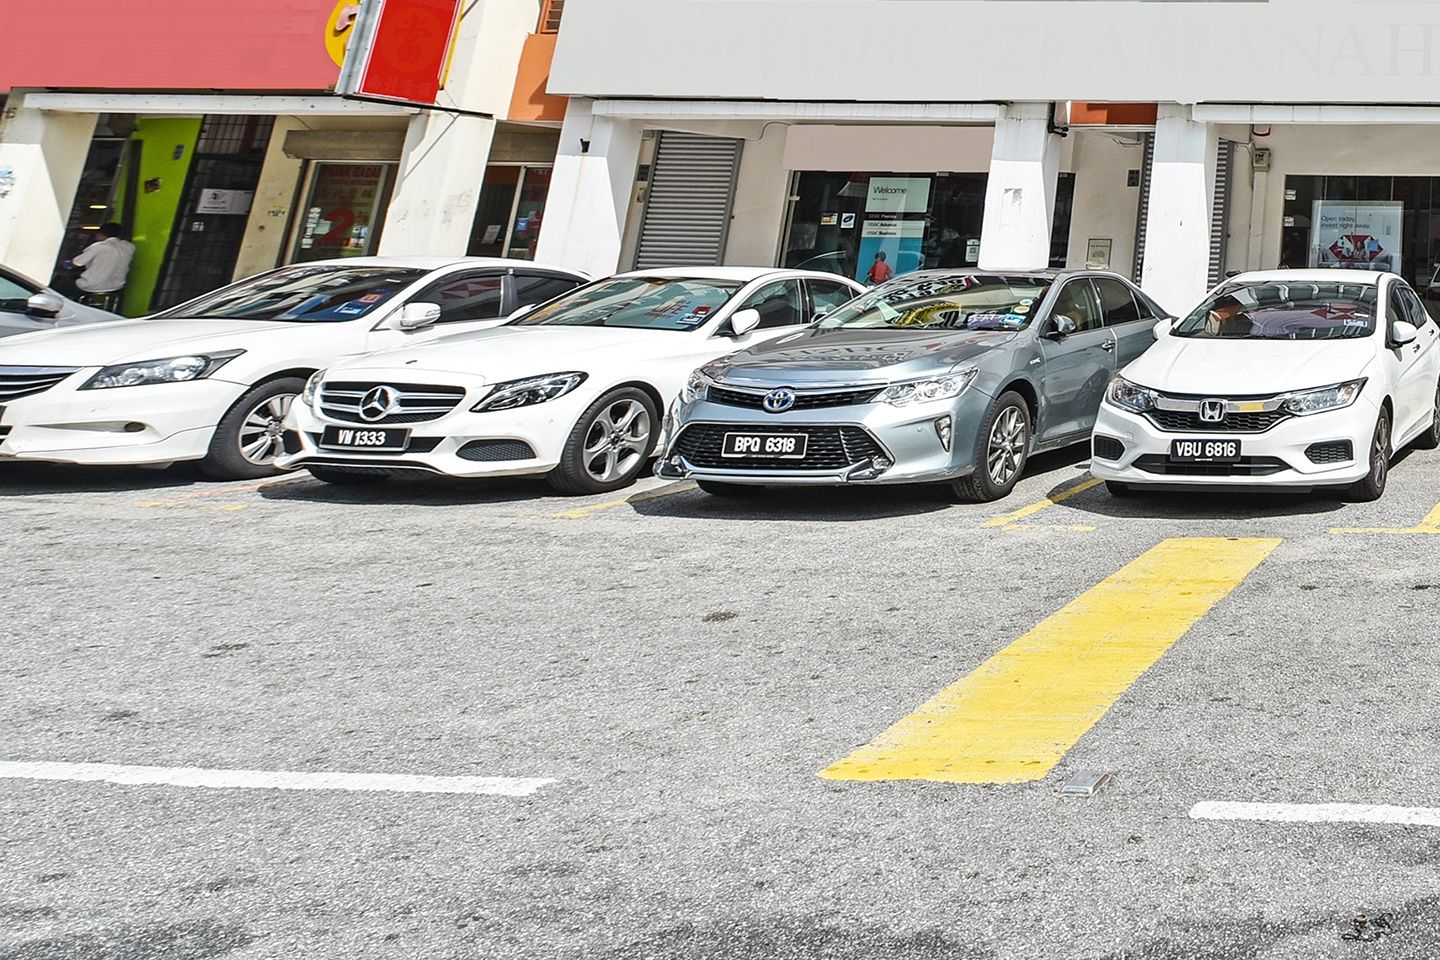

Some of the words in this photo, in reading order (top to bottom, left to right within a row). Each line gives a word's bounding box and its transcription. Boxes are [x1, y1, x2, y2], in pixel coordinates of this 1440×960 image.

[873, 186, 908, 195] Welcome
[1321, 215, 1337, 223] Open
[354, 430, 386, 446] 1333
[734, 436, 761, 452] BPQ
[765, 437, 796, 453] 6318
[1176, 441, 1202, 457] VBU
[1205, 441, 1236, 457] 6816
